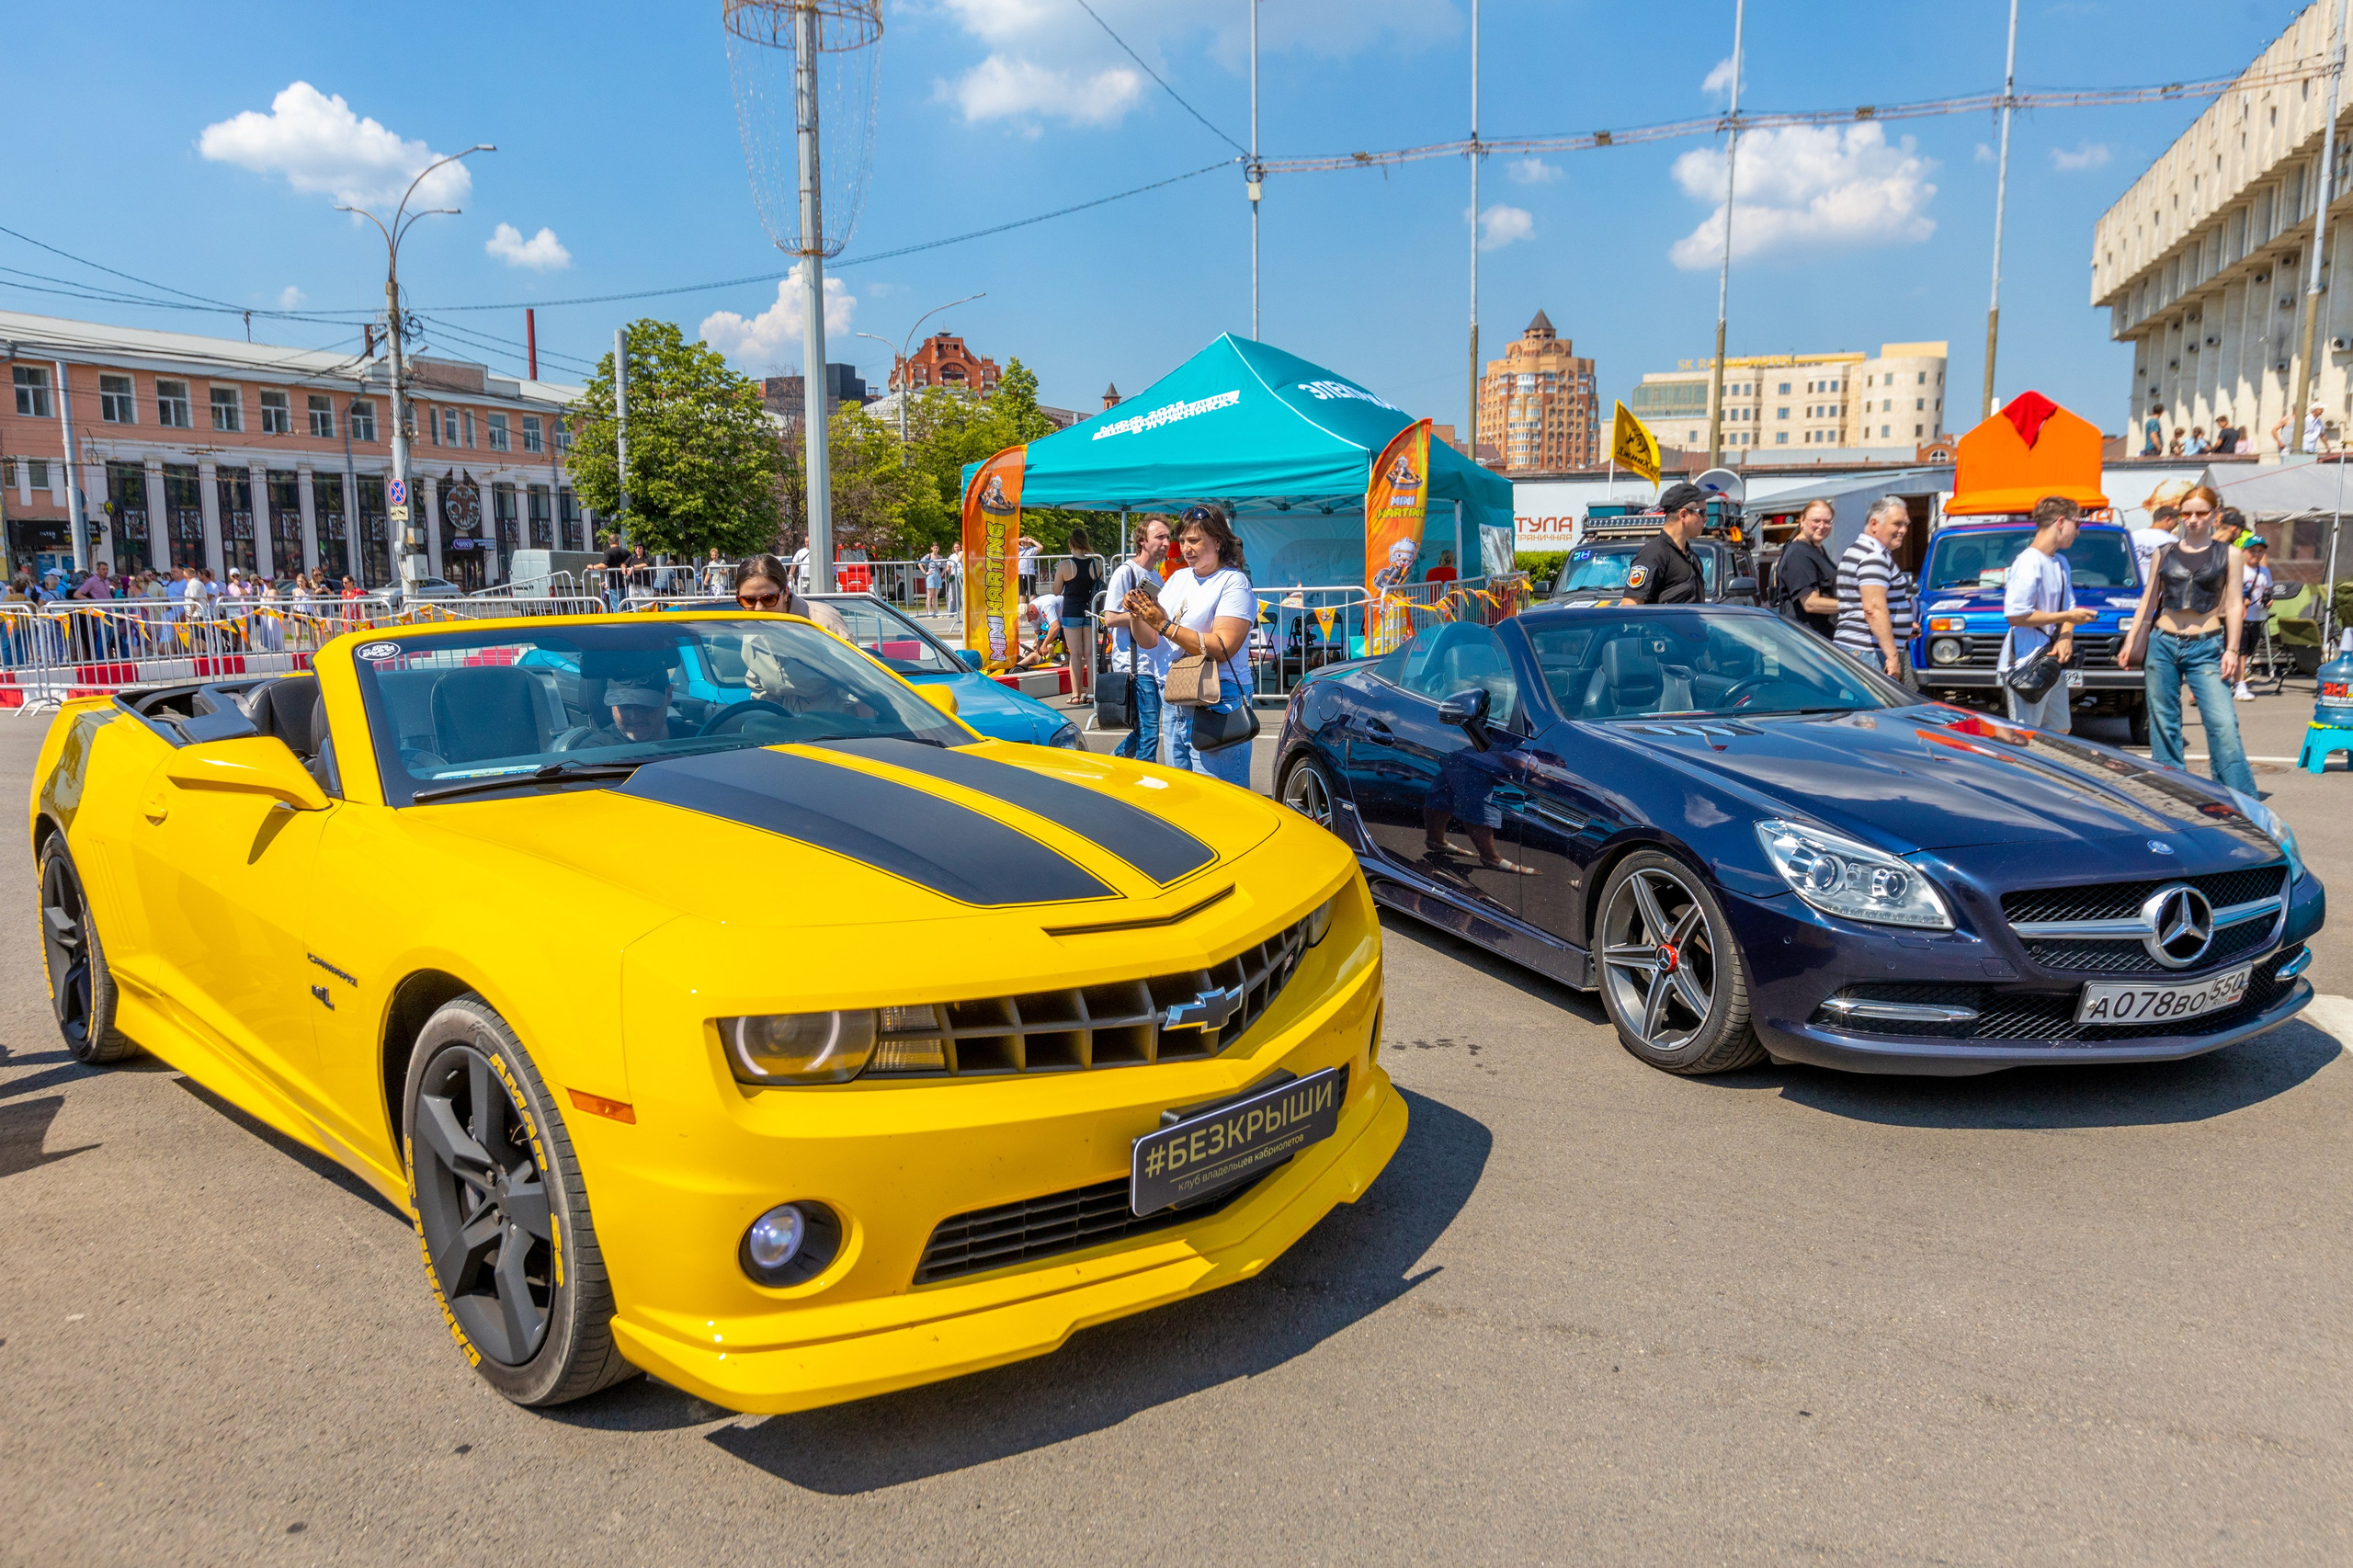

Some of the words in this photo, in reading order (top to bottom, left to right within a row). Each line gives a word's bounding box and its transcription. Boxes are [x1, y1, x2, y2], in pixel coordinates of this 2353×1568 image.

[1390, 495, 1416, 506] MINI
[1514, 517, 1573, 533] ТУЛА
[2088, 991, 2207, 1019] А078ВО
[2210, 971, 2245, 1002] 550
[2211, 995, 2229, 1007] RUS
[1145, 1080, 1332, 1178] #БЕЗКРЫШИ
[1178, 1173, 1201, 1192] клуб
[1202, 1155, 1254, 1183] владельцев
[1254, 1133, 1304, 1162] кабриолетов
